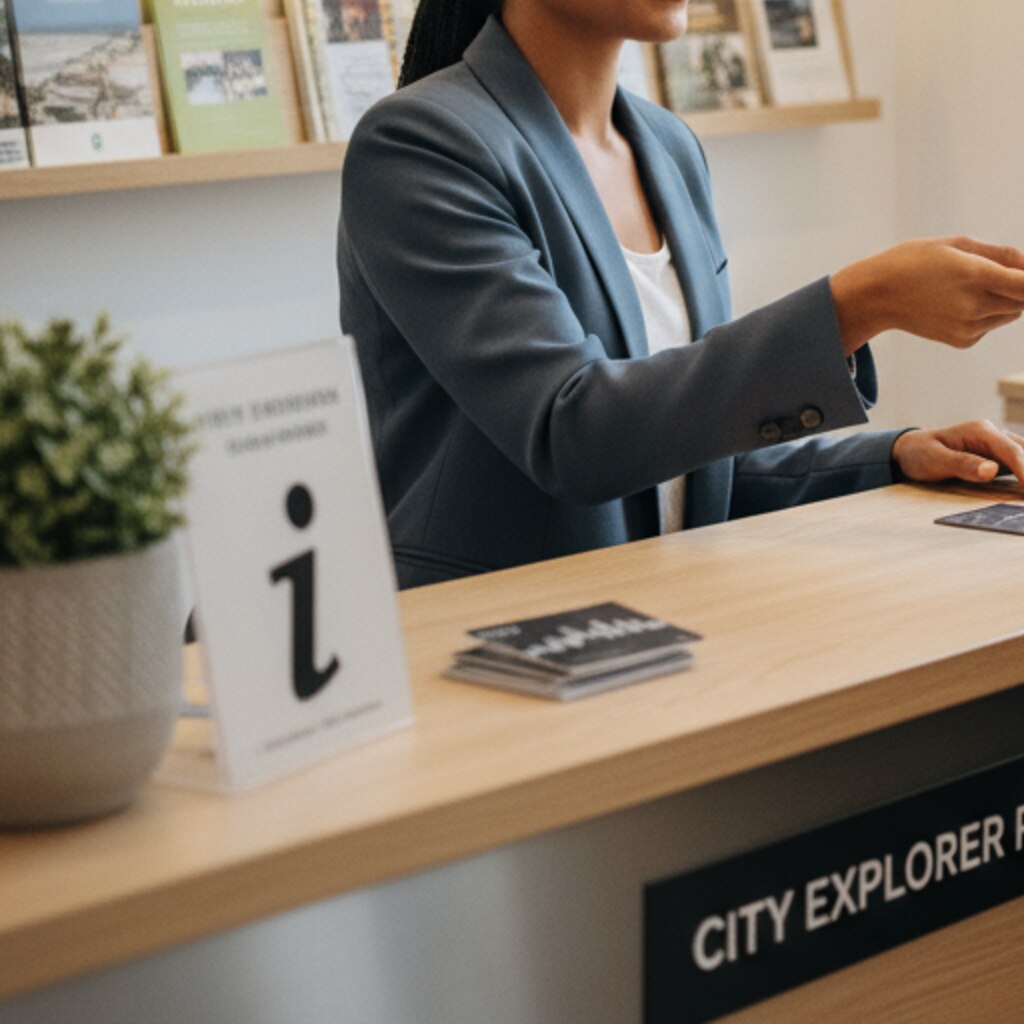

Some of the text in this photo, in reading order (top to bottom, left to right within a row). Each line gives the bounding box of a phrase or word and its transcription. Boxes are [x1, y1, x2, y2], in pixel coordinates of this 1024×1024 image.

[268, 481, 341, 704] i
[691, 888, 795, 972] CITY
[805, 813, 1006, 932] EXPLORER
